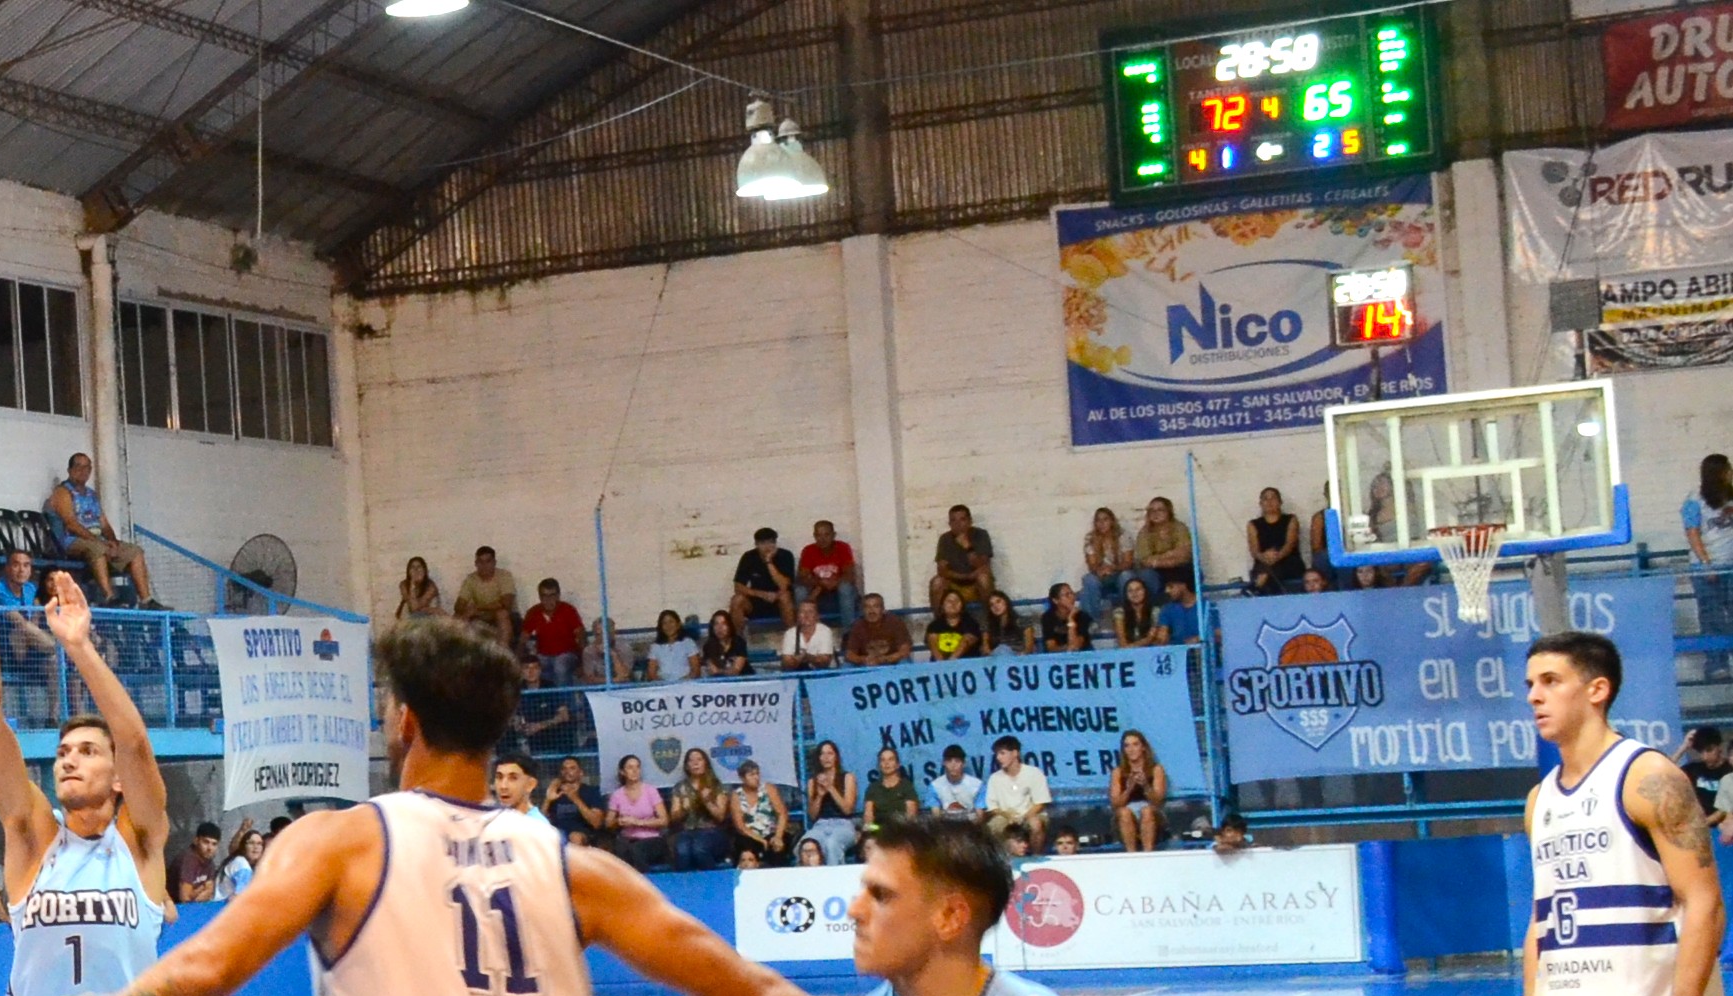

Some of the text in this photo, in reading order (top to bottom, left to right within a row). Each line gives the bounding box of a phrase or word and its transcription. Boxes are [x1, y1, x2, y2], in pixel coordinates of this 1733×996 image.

[1216, 33, 1318, 81] 28:58
[1203, 95, 1245, 131] 72
[1261, 96, 1279, 119] 4
[1304, 79, 1352, 121] 65
[1313, 133, 1331, 158] 2
[1342, 129, 1360, 154] 5
[1189, 149, 1206, 171] 4
[1095, 184, 1390, 232] SNACKS GOLOSINAS GALLETITAS CEREALES
[1167, 281, 1304, 366] Nico
[1363, 300, 1402, 339] 14
[1188, 345, 1291, 365] DISTRIBUCIONES
[1109, 406, 1128, 420] DE
[1129, 403, 1156, 419] LOS
[1157, 400, 1204, 417] RUSOS
[1206, 397, 1232, 412] 477
[1242, 394, 1270, 409] SAN
[1272, 386, 1343, 406] SALVADOR
[1353, 380, 1397, 397] ENRE
[1399, 377, 1434, 393] ROS
[1158, 412, 1252, 433] 345-4014171
[243, 628, 303, 659] SPORTIVO
[851, 660, 1137, 711] SPORTIVO Y SU GENTE
[1230, 659, 1384, 715] SPORTIVO
[621, 692, 780, 715] BOCA Y SPORTIVO
[621, 706, 779, 732] UN SOLO CORAZÓN
[879, 706, 1120, 751] KAKI KACHENGUE
[291, 761, 340, 789] RODRIGUEZ
[866, 763, 913, 788] SN
[1536, 831, 1610, 862] ATLTICO
[1552, 861, 1589, 881] ALA
[21, 889, 138, 931] PORTIVO
[1094, 886, 1341, 917] CABAÑA ARASY
[1554, 893, 1575, 940] 6
[452, 883, 540, 995] 11
[64, 934, 83, 986] 1
